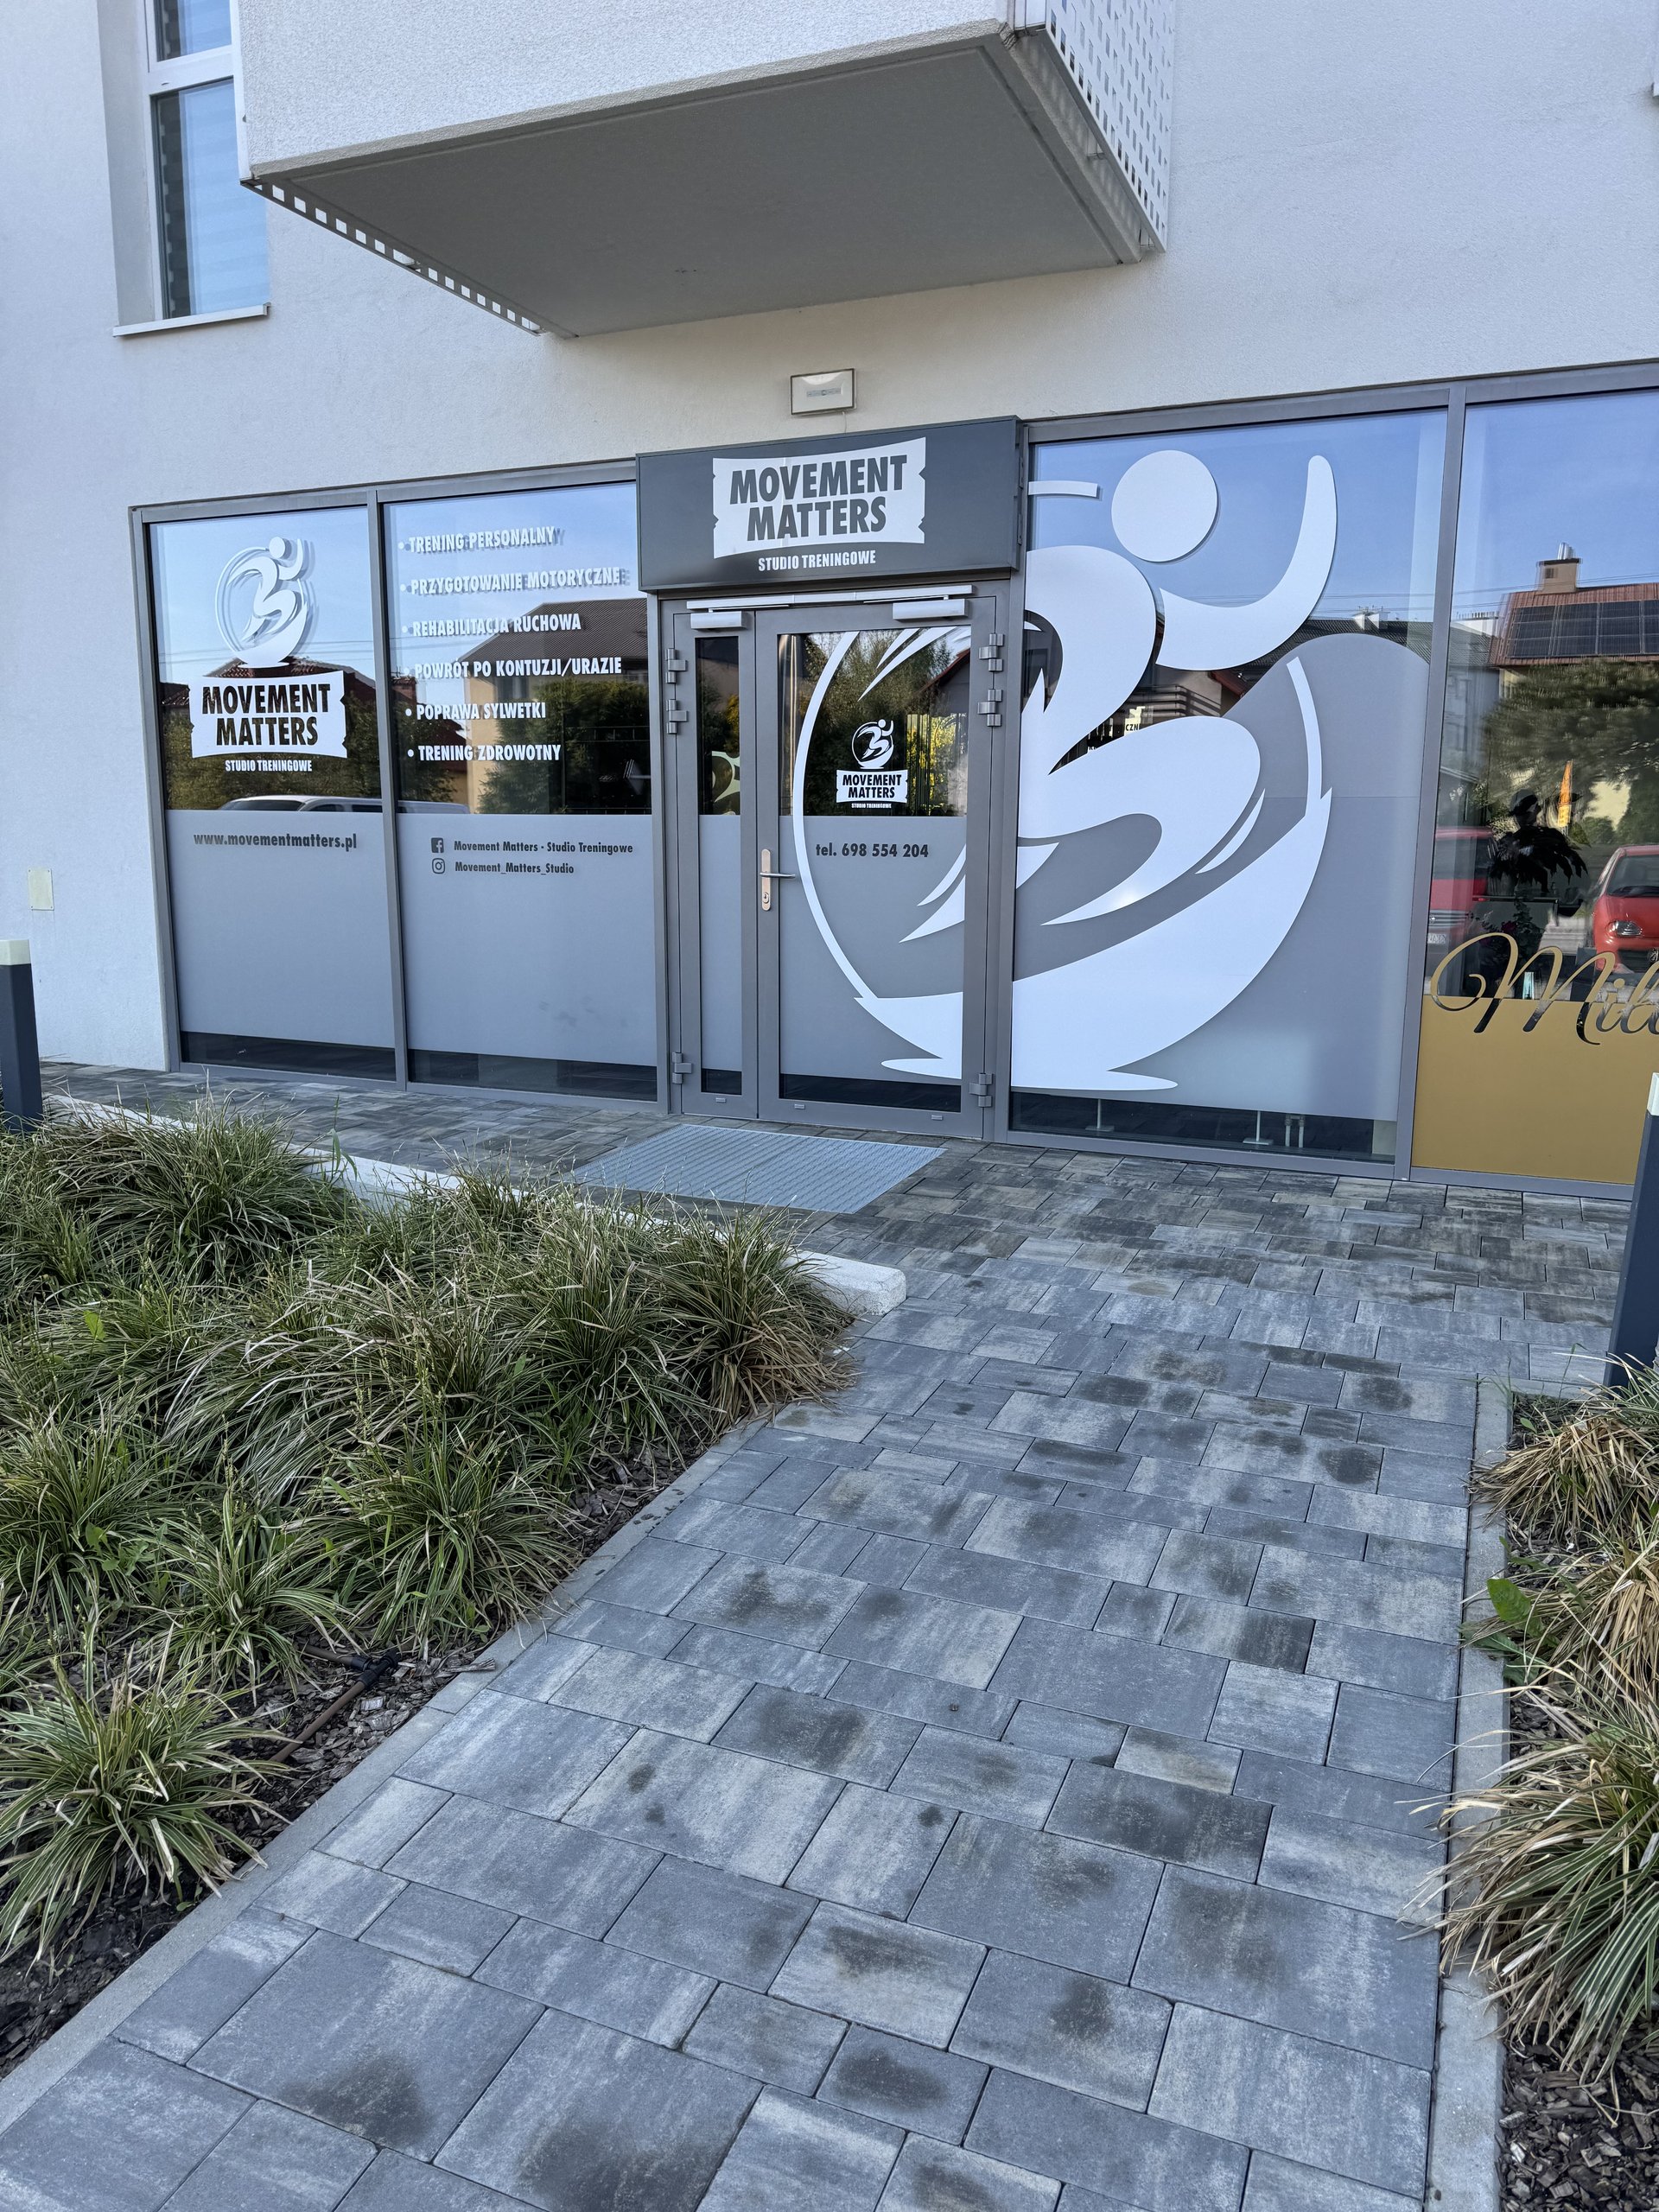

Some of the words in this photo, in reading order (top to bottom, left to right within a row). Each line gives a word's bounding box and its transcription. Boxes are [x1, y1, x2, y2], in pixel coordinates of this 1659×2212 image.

[729, 454, 907, 504] MOVEMENT
[747, 496, 887, 541] MATTERS
[409, 533, 464, 553] TRENING
[469, 525, 556, 548] PERSONALNY
[758, 554, 799, 571] STUDIO
[802, 550, 876, 569] TRENINGOWE
[410, 573, 522, 594] PRZYGOTOWANIE
[527, 567, 620, 588] MOTORYCZNE
[412, 617, 509, 637] REHABILITACJA
[513, 613, 582, 632] RUCHOWA
[474, 661, 491, 677] PO
[496, 657, 622, 677] KONTUZJI/URAZIE
[201, 683, 331, 715] MOVEMENT
[416, 703, 480, 720] POPRAWA
[484, 702, 546, 720] SYLWETKI
[216, 716, 318, 746] MATTERS
[418, 745, 474, 761] TRENING
[478, 744, 561, 760] ZDROWOTNY
[225, 760, 256, 772] STUDIO
[257, 760, 313, 772] TRENINGOWE
[842, 774, 902, 785] MOVEMENT
[848, 787, 895, 798] MATTERS
[194, 833, 357, 852] www.movementmatters.pl
[454, 841, 500, 851] Movement
[502, 841, 538, 852] Matters
[547, 842, 575, 852] Studio
[578, 842, 633, 855] Treningowe
[816, 842, 836, 856] tel.
[842, 843, 867, 856] 698
[872, 844, 898, 857] 554
[902, 844, 929, 857] 204
[454, 861, 574, 875] Movement_Matters_Studio
